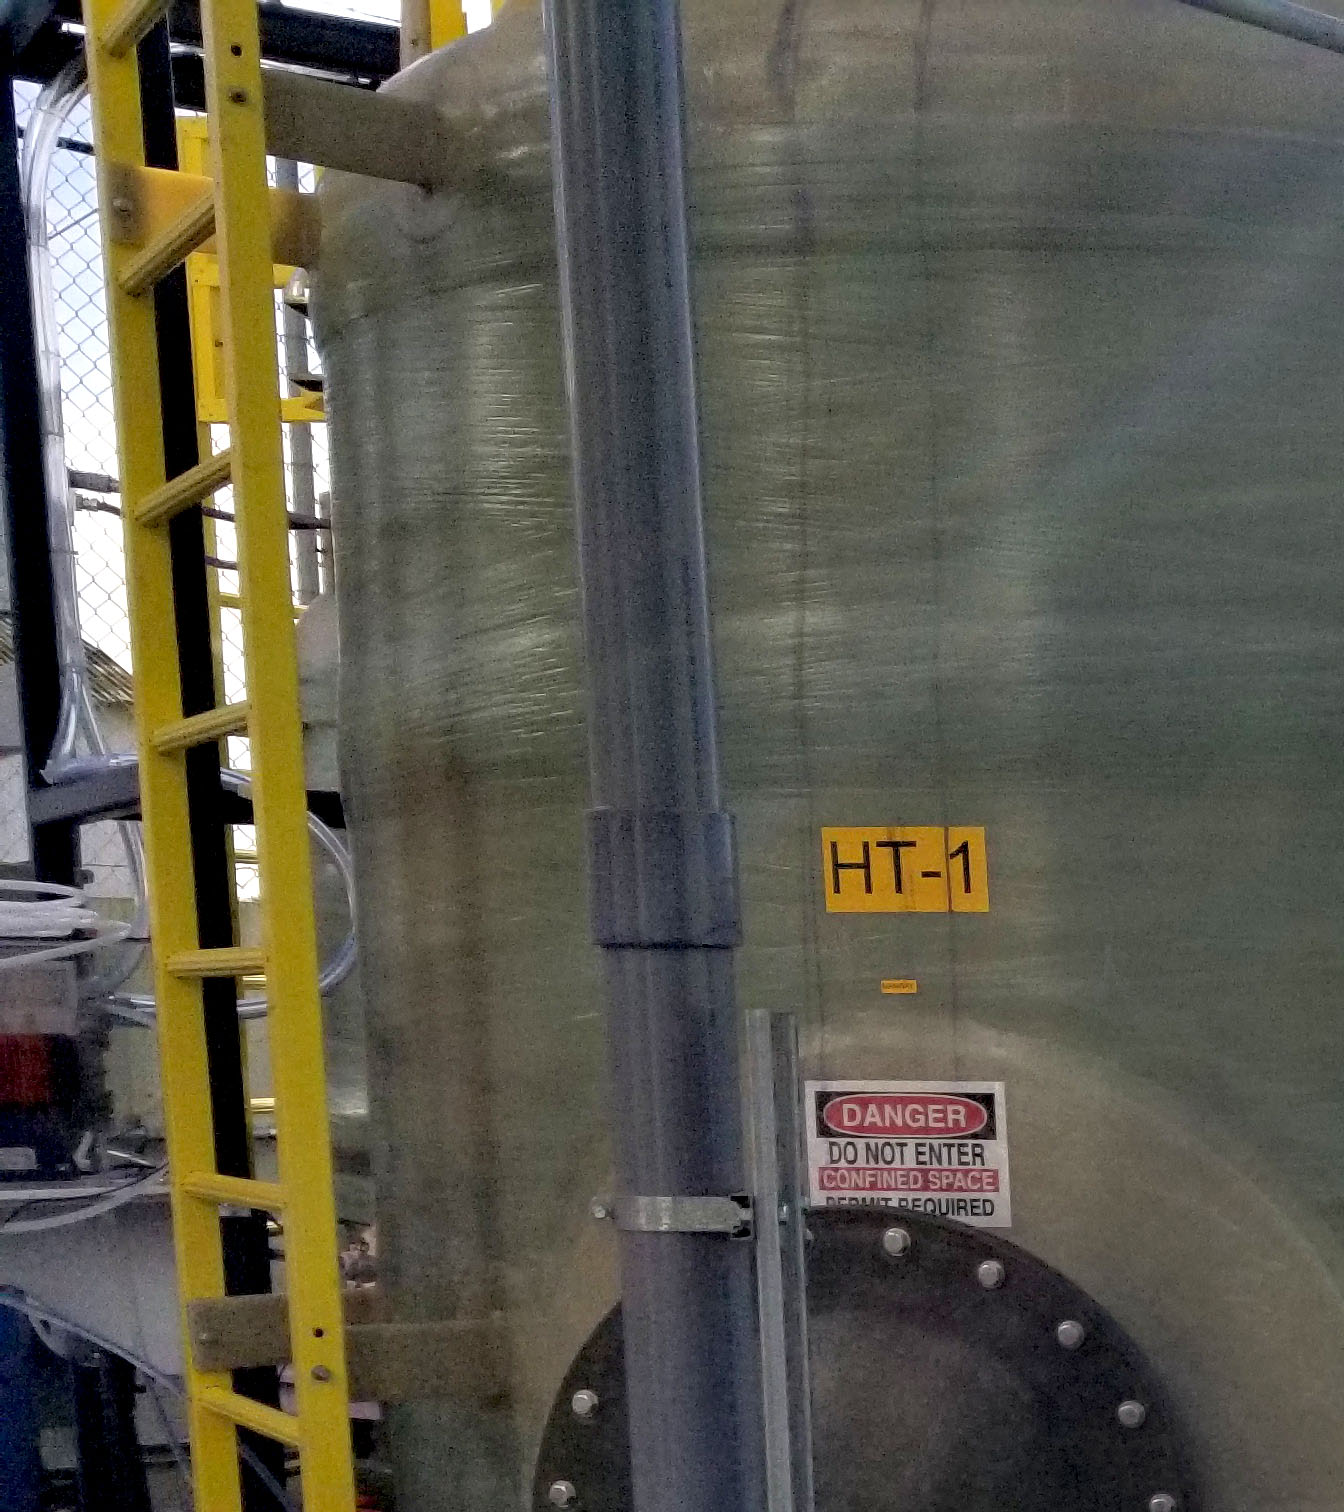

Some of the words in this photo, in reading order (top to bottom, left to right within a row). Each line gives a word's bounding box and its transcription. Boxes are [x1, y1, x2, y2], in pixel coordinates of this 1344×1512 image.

[829, 840, 972, 895] HT-1
[842, 1103, 967, 1128] DANGER
[828, 1141, 858, 1165] DO
[865, 1142, 908, 1166] NOT
[915, 1142, 986, 1167] ENTER
[822, 1169, 922, 1189] CONFINED
[928, 1170, 997, 1190] SPACE
